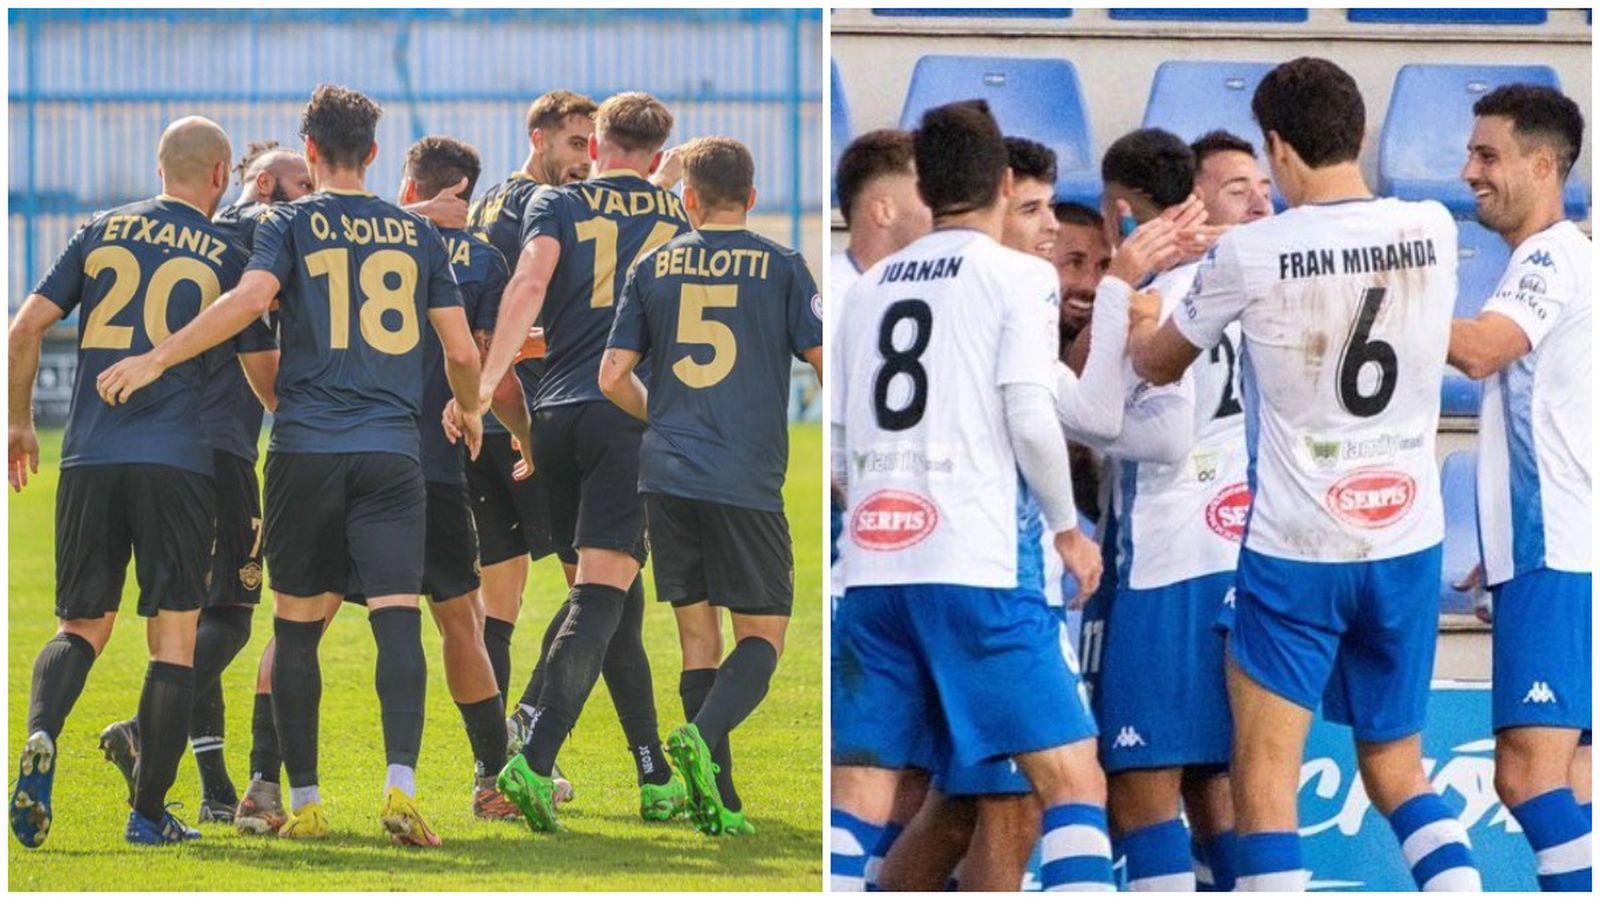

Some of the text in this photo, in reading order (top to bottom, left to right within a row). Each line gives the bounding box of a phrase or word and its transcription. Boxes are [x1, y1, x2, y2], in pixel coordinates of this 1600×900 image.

[581, 187, 687, 222] VADIK
[103, 215, 227, 266] ETXANIZ
[310, 212, 419, 247] O. SOLDE
[655, 248, 770, 280] BELLOTTI
[878, 256, 964, 285] JUANAN
[1279, 239, 1437, 279] FRAN MIRANDA
[81, 245, 221, 350] 20
[304, 248, 420, 355] 18
[671, 283, 738, 389] 5
[1336, 287, 1398, 418] 6
[873, 298, 933, 431] 8
[1341, 483, 1407, 512] SERPIS
[249, 517, 263, 558] 7
[857, 511, 926, 532] SERPIS
[1081, 620, 1104, 673] 11
